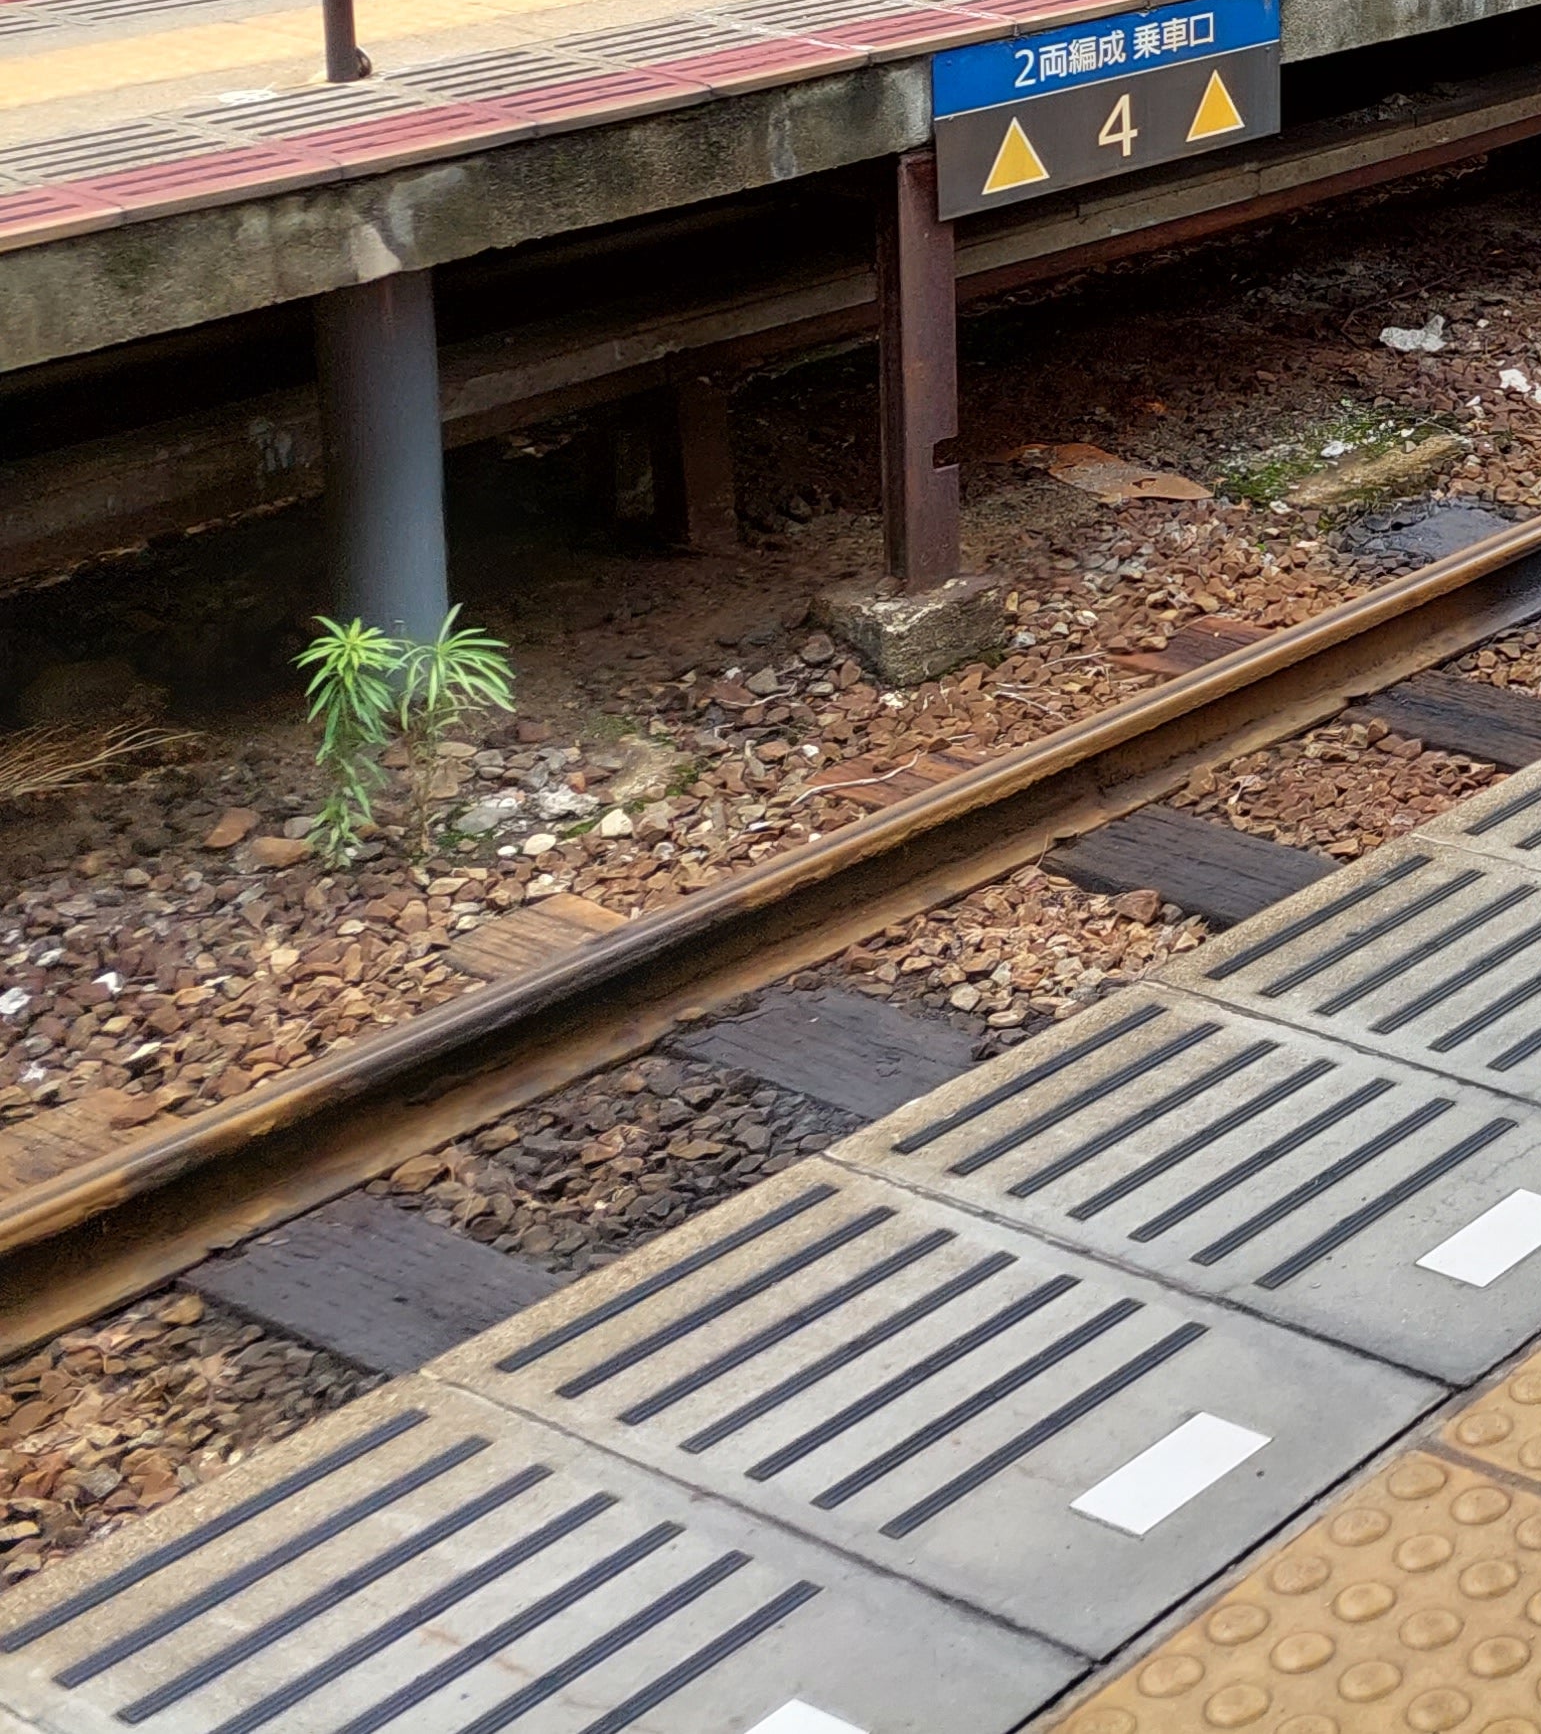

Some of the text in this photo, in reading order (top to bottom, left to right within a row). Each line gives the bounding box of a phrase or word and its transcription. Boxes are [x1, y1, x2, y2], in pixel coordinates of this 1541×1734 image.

[1013, 12, 1215, 88] 2両編成 乗車口
[1098, 93, 1138, 157] 4
